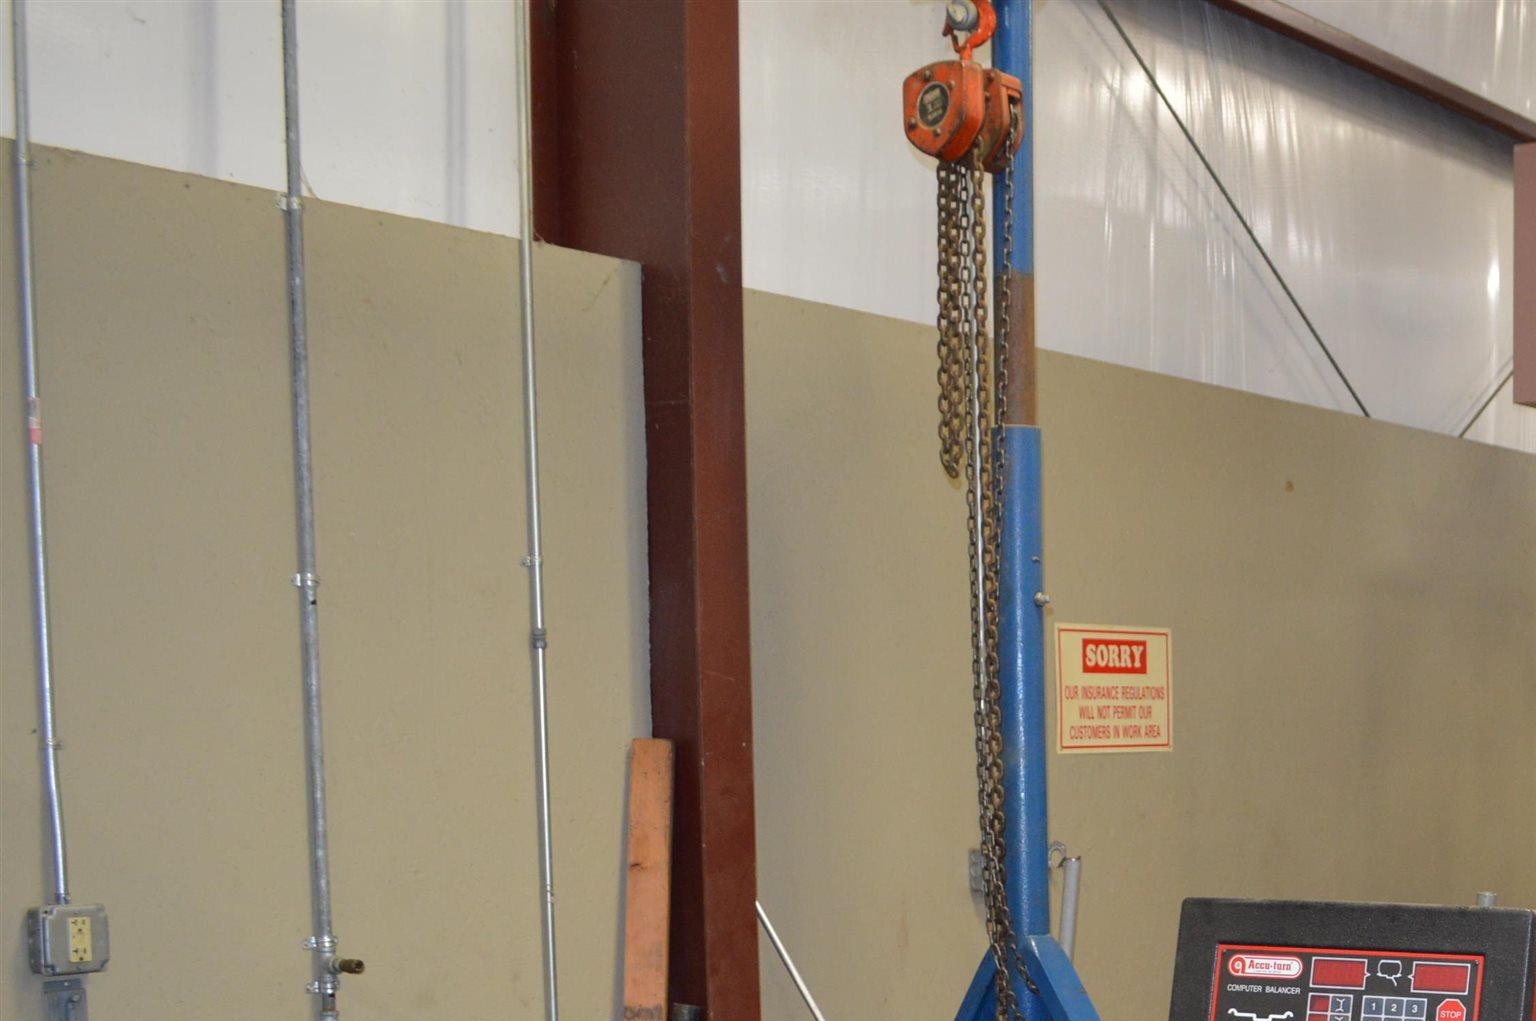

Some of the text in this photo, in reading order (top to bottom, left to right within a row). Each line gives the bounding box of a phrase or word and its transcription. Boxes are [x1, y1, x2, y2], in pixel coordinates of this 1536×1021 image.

[1085, 644, 1144, 668] SORRY
[1064, 685, 1165, 700] OUR INSURANCE REGULATIONS
[1079, 705, 1152, 720] WILL NOT PERMIT OUR
[1069, 724, 1161, 740] CUSTOMERS IN WORK AREA
[1227, 984, 1301, 995] COMPUTER BALANCER
[1371, 1003, 1376, 1011] 1
[1391, 1004, 1397, 1012] 2
[1411, 1005, 1418, 1013] 3
[1440, 1010, 1462, 1019] STOP
